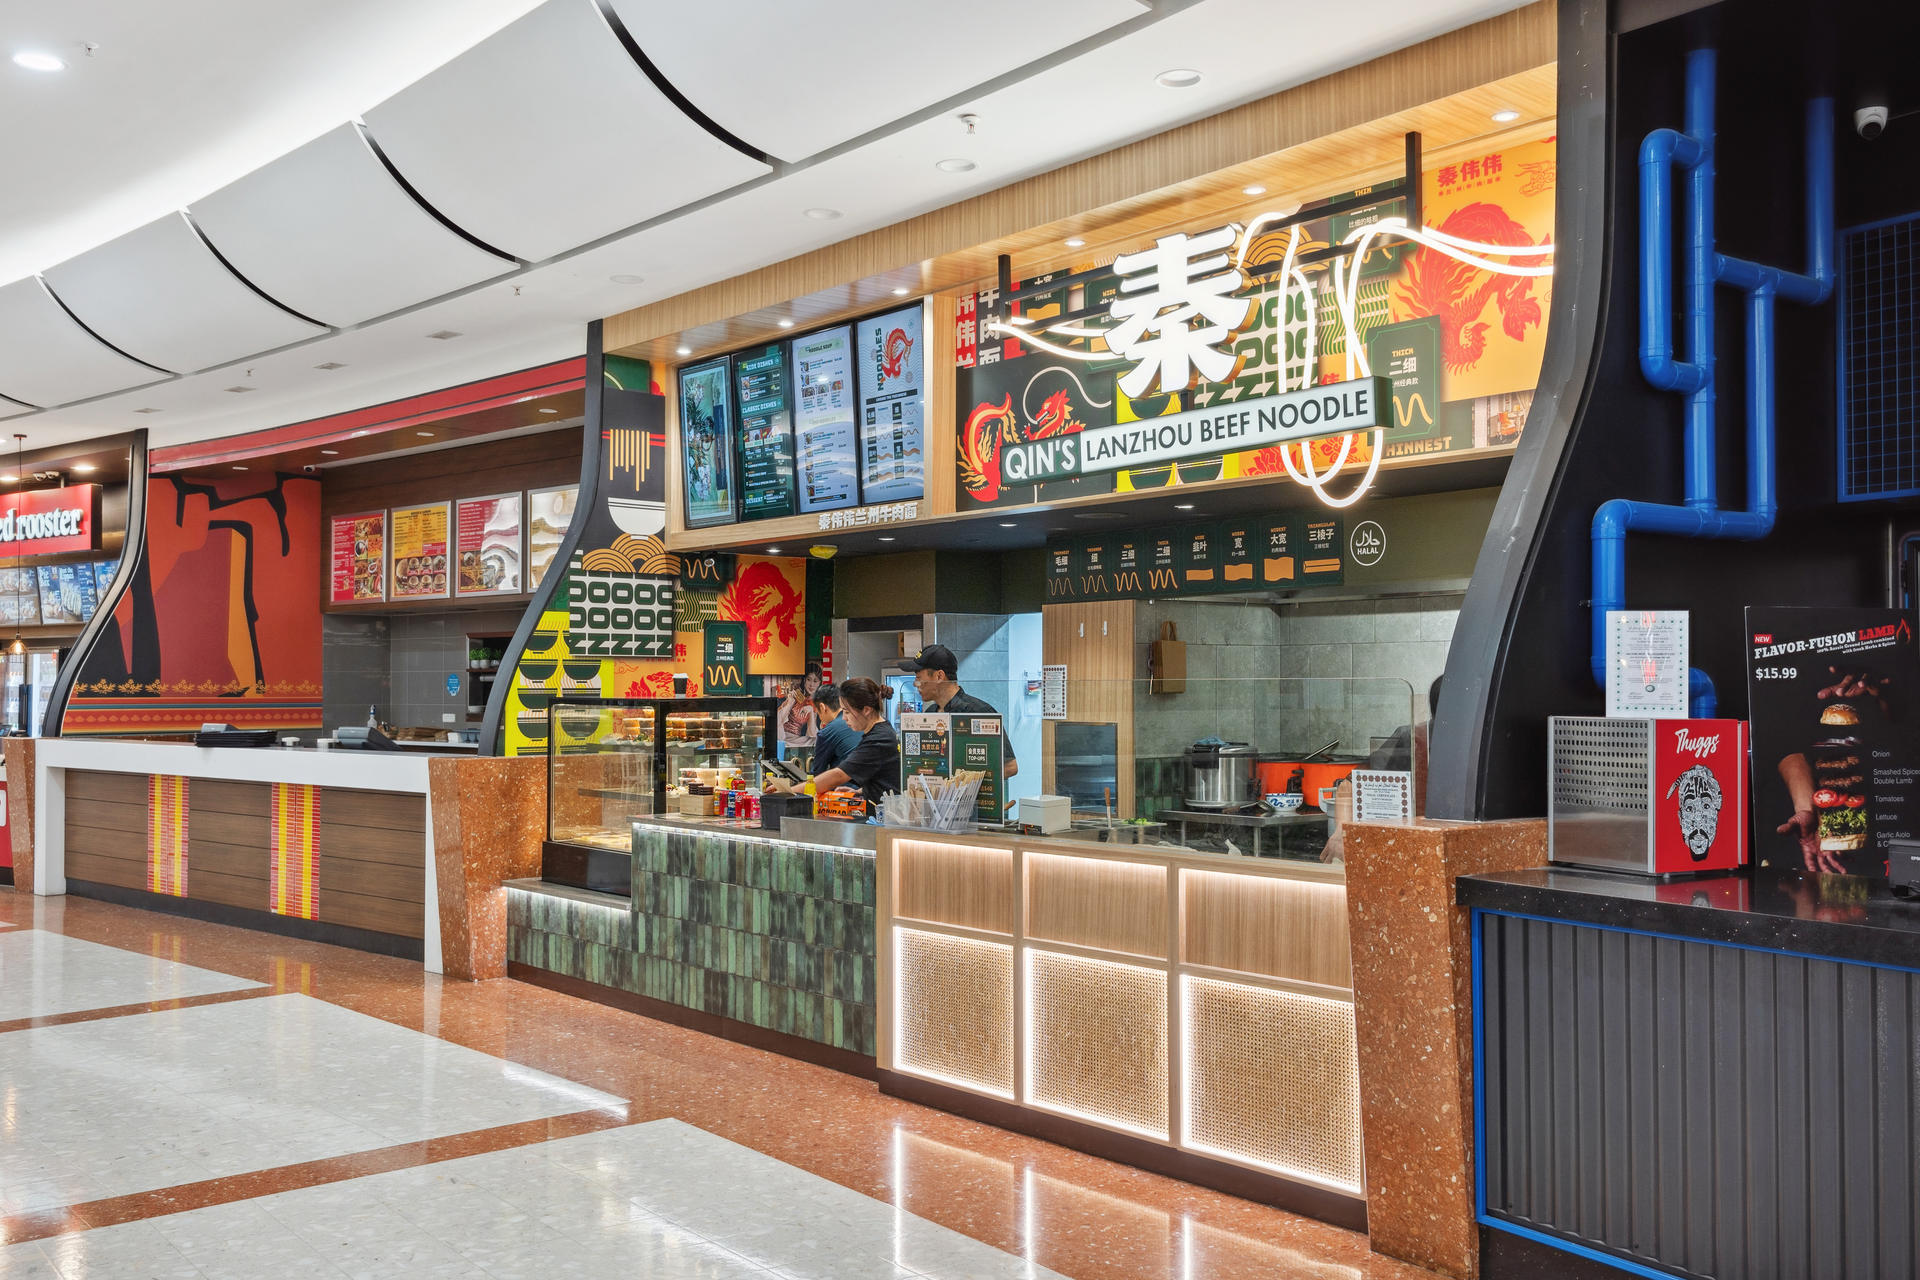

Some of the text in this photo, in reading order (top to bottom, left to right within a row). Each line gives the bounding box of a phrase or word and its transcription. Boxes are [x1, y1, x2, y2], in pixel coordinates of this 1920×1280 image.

[1437, 154, 1502, 187] 秦伟伟
[1354, 186, 1372, 197] THIN
[1103, 223, 1254, 399] 秦
[875, 328, 884, 392] NOODLES
[1389, 356, 1417, 376] 二细
[1392, 377, 1419, 388] 州经典款
[1005, 389, 1368, 481] QIN'S LANZHOU BEEF NOODLE
[1386, 436, 1452, 457] HINNEST
[16, 508, 82, 540] rooster
[1270, 533, 1287, 545] 大宽
[1355, 529, 1380, 547] حلال
[716, 643, 733, 653] 二细
[1754, 624, 1896, 660] FLAVOR-FUSION LAMB
[1755, 667, 1797, 681] $15.99
[1675, 728, 1720, 758] Thuggs
[1872, 750, 1890, 758] Onion
[1873, 768, 1901, 776] Smashed
[1873, 777, 1895, 785] Double
[1874, 795, 1904, 803] Tomatoes
